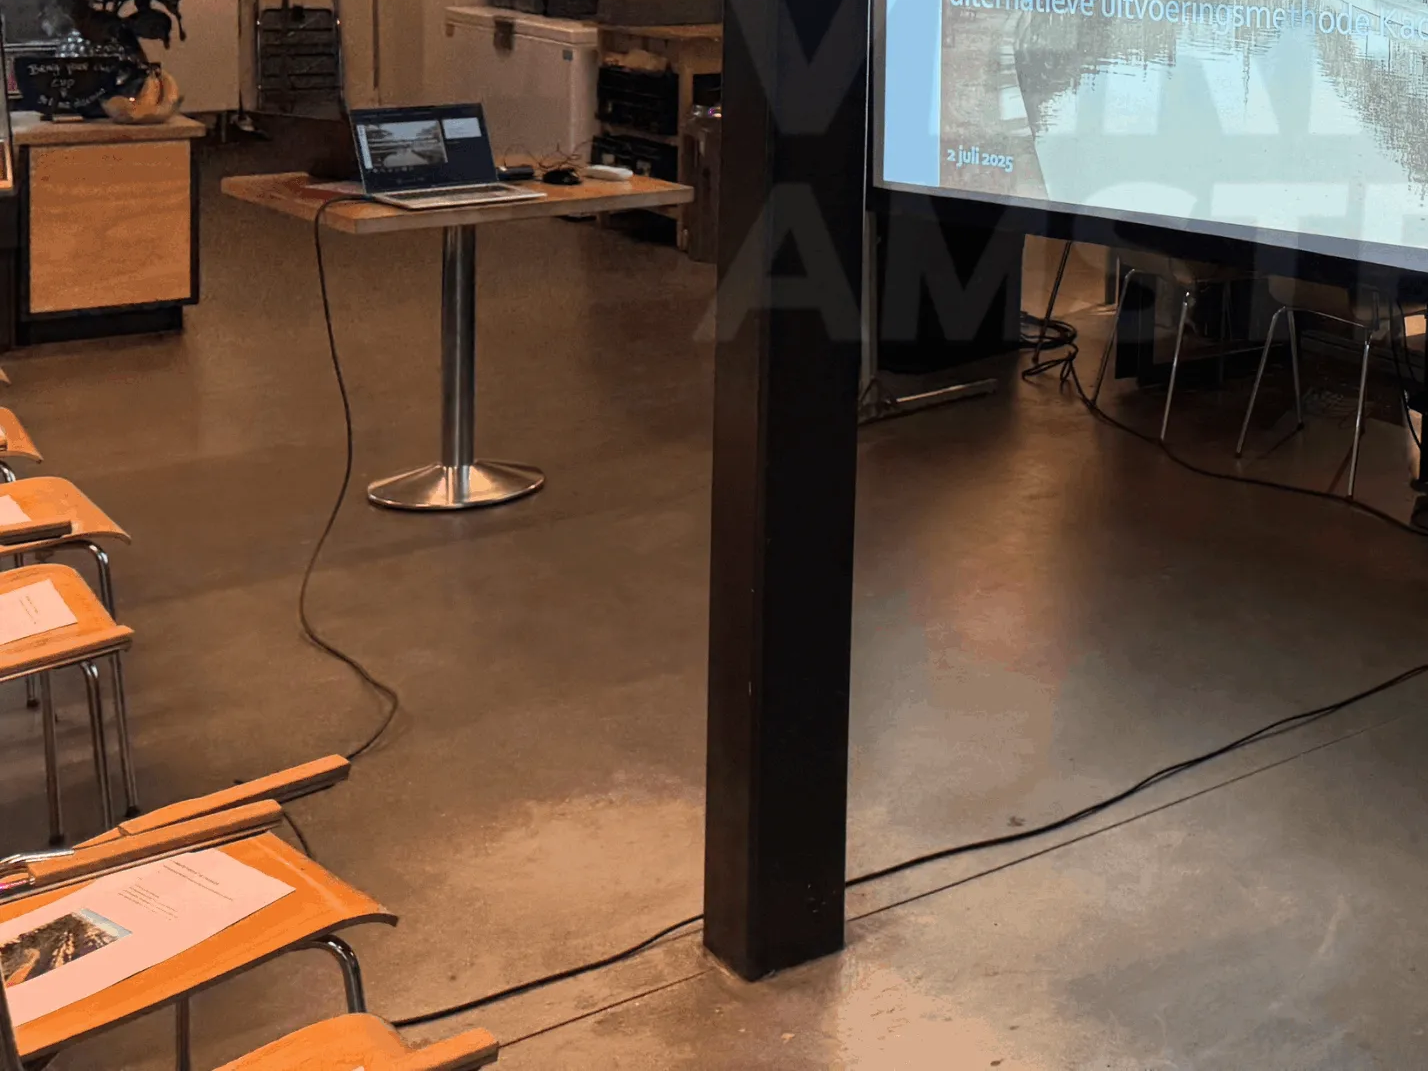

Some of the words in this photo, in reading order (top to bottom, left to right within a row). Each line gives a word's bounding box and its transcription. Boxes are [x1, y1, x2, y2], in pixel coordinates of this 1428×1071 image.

[947, 149, 956, 161] 2
[956, 146, 980, 170] juli
[982, 152, 1014, 173] 2025
